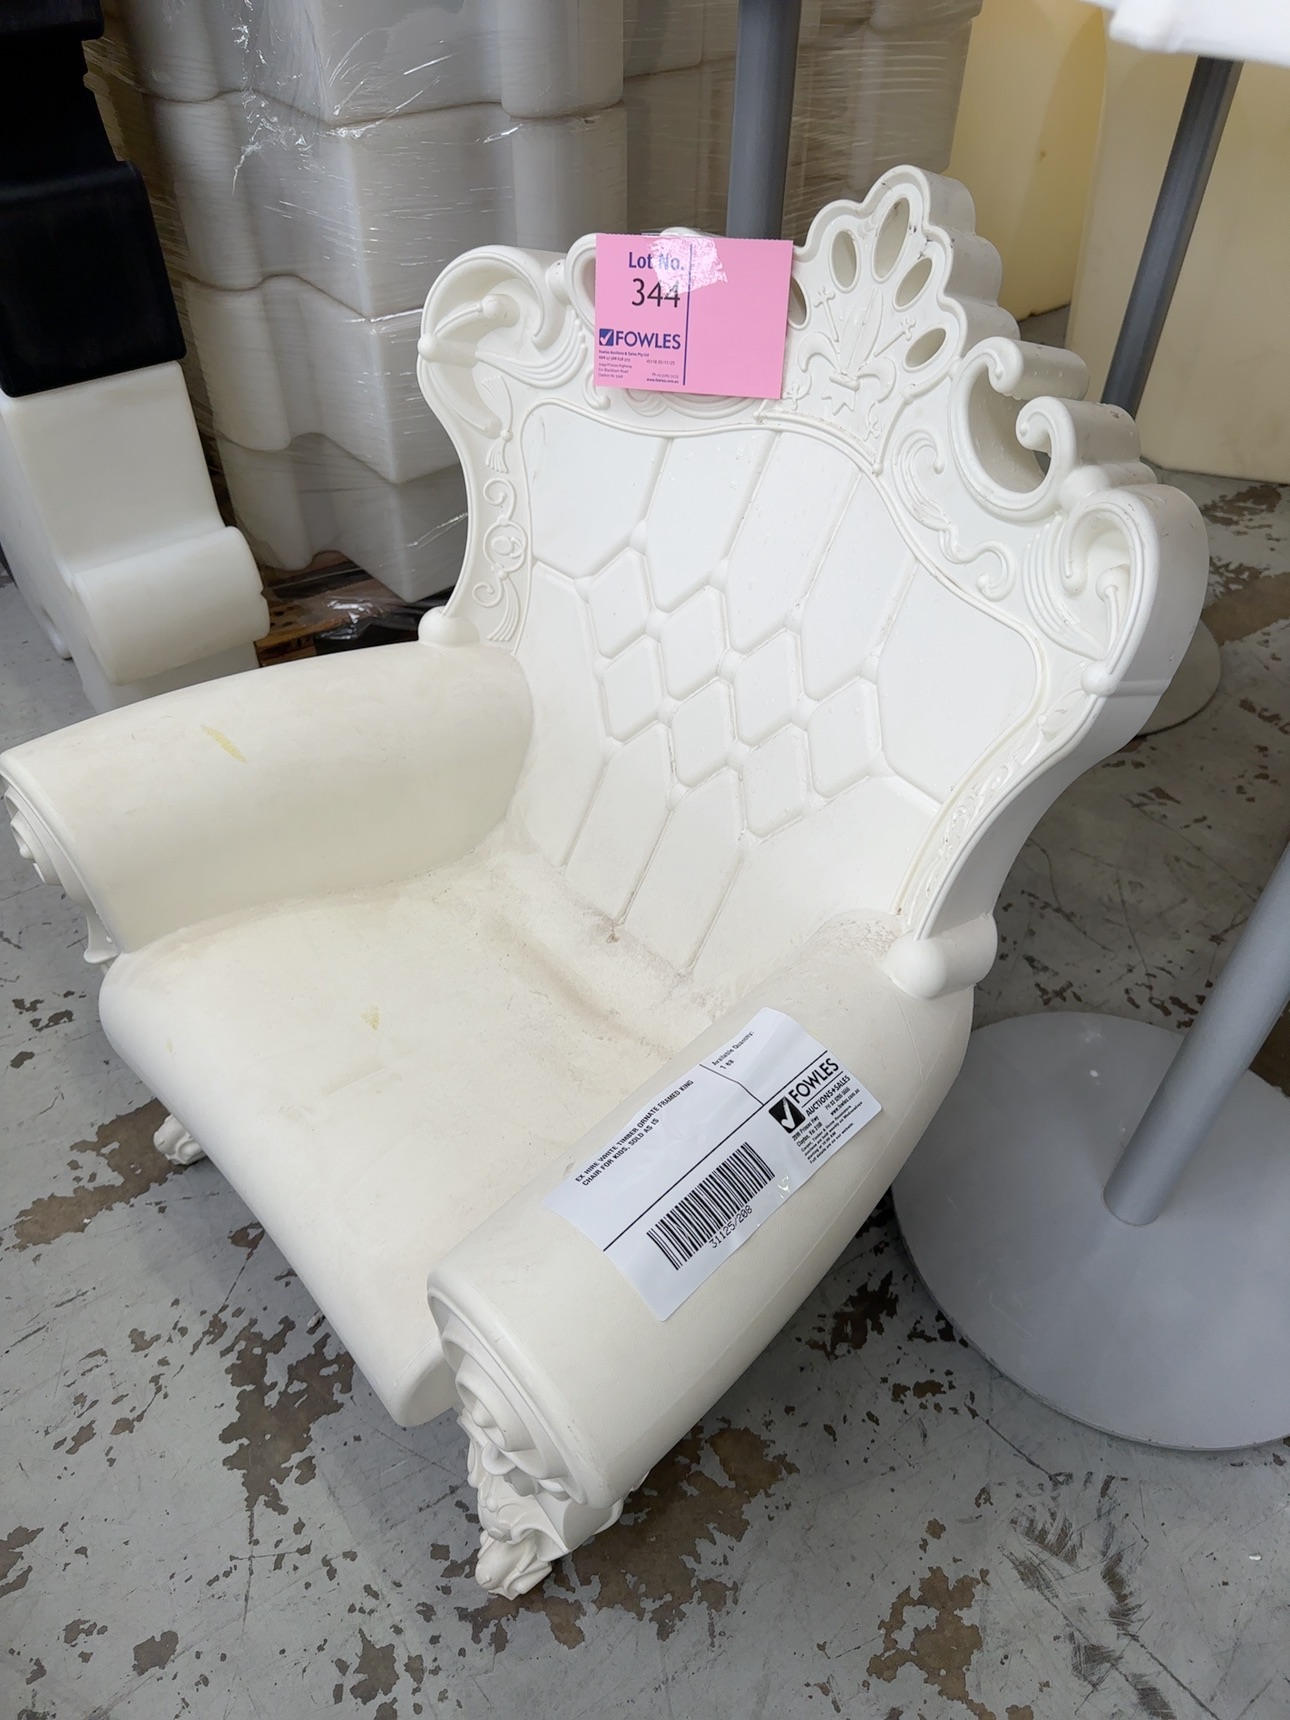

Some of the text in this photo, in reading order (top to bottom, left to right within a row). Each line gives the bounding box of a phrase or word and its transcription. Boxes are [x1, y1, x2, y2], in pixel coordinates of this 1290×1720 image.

[628, 251, 685, 271] Lot No.
[631, 278, 680, 308] 344
[616, 330, 681, 350] FOWLES
[788, 1058, 839, 1104] FOWLES
[805, 1075, 851, 1117] AUCTIONS+SALES
[575, 1080, 694, 1182] EX HIRE WHITE TIMBER ORNATE FRAMED KING
[582, 1118, 660, 1186] CHAIR FOR KIDS, SOLD AS IS
[709, 1205, 752, 1248] 31125/208
